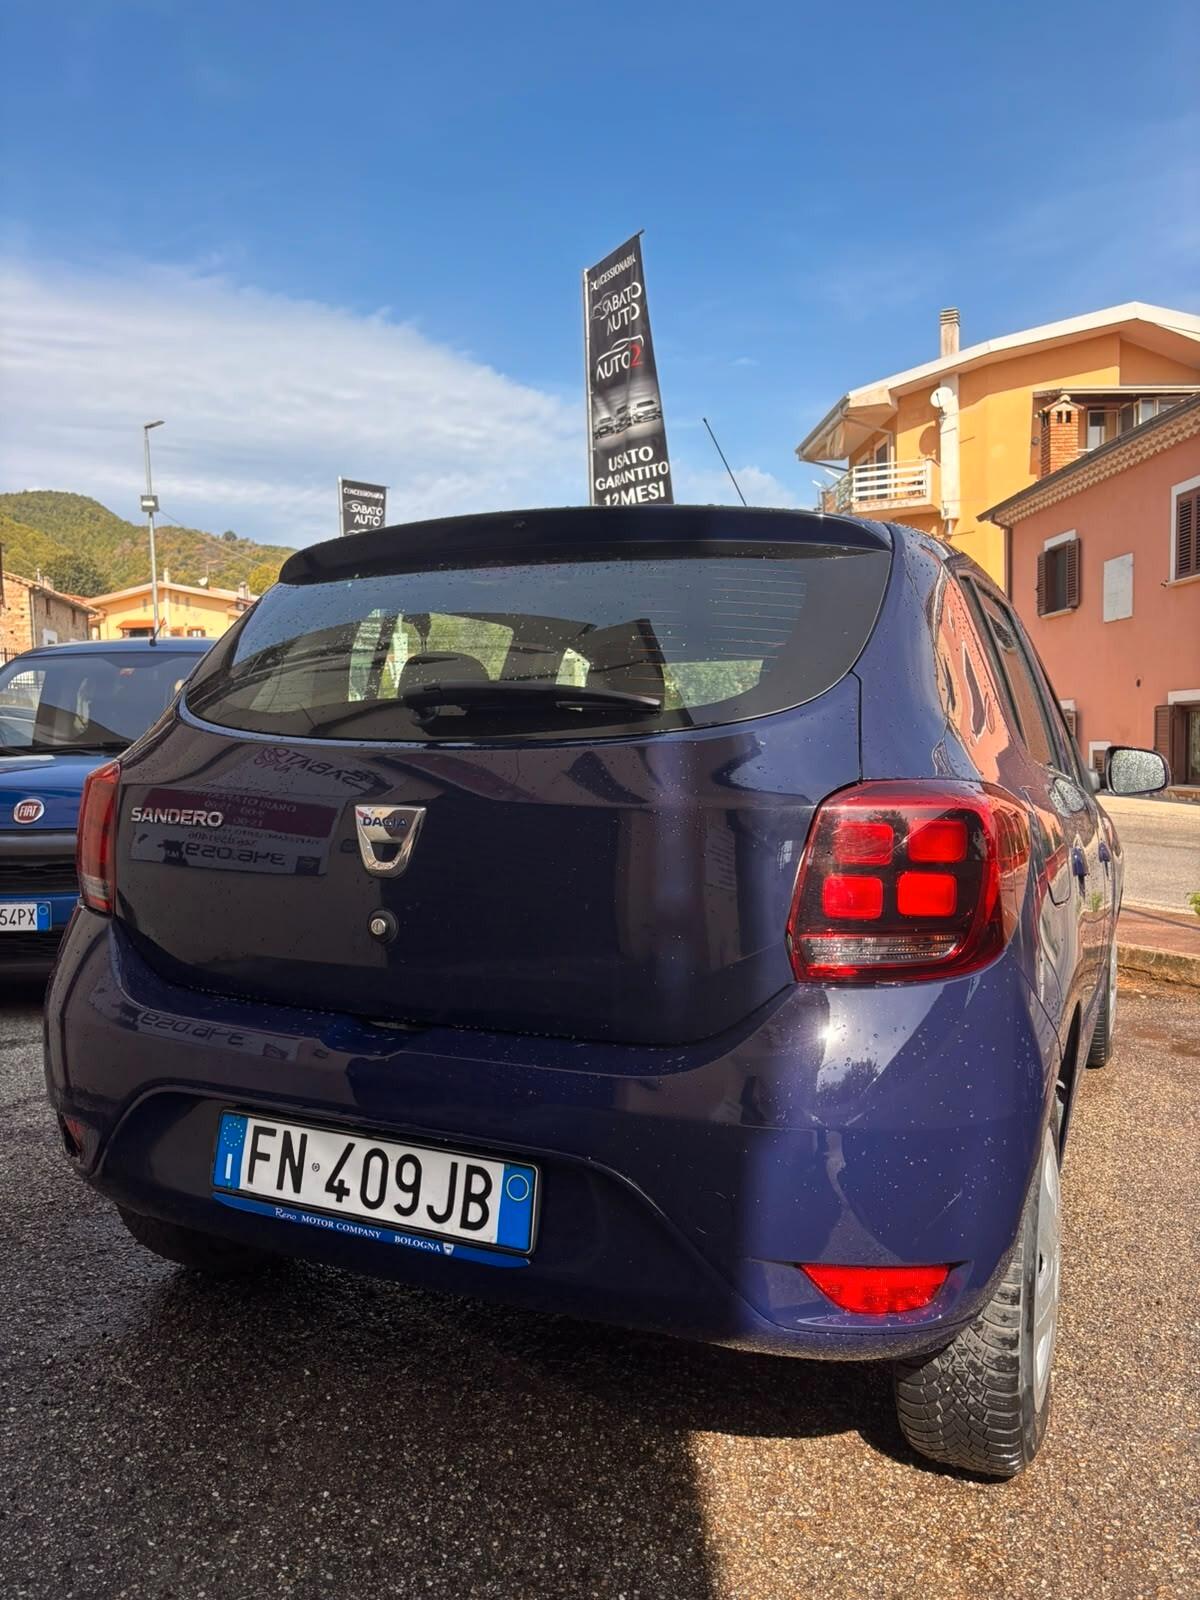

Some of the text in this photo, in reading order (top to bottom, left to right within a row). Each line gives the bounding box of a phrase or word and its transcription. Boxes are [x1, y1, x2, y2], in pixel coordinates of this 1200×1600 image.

[600, 281, 642, 321] SABATO
[607, 303, 640, 336] AUTO
[608, 446, 654, 471] USATO
[595, 461, 669, 491] GARANTITO
[350, 503, 383, 517] SABATO
[354, 515, 381, 527] AUTO
[18, 805, 38, 817] FIAT
[130, 806, 224, 828] SANDERO
[362, 816, 407, 827] DACIA
[0, 908, 36, 926] 54PX
[246, 1125, 494, 1231] FN 409JB
[274, 1207, 441, 1253] Reno MOTOR COMPANY BOLOGNA
